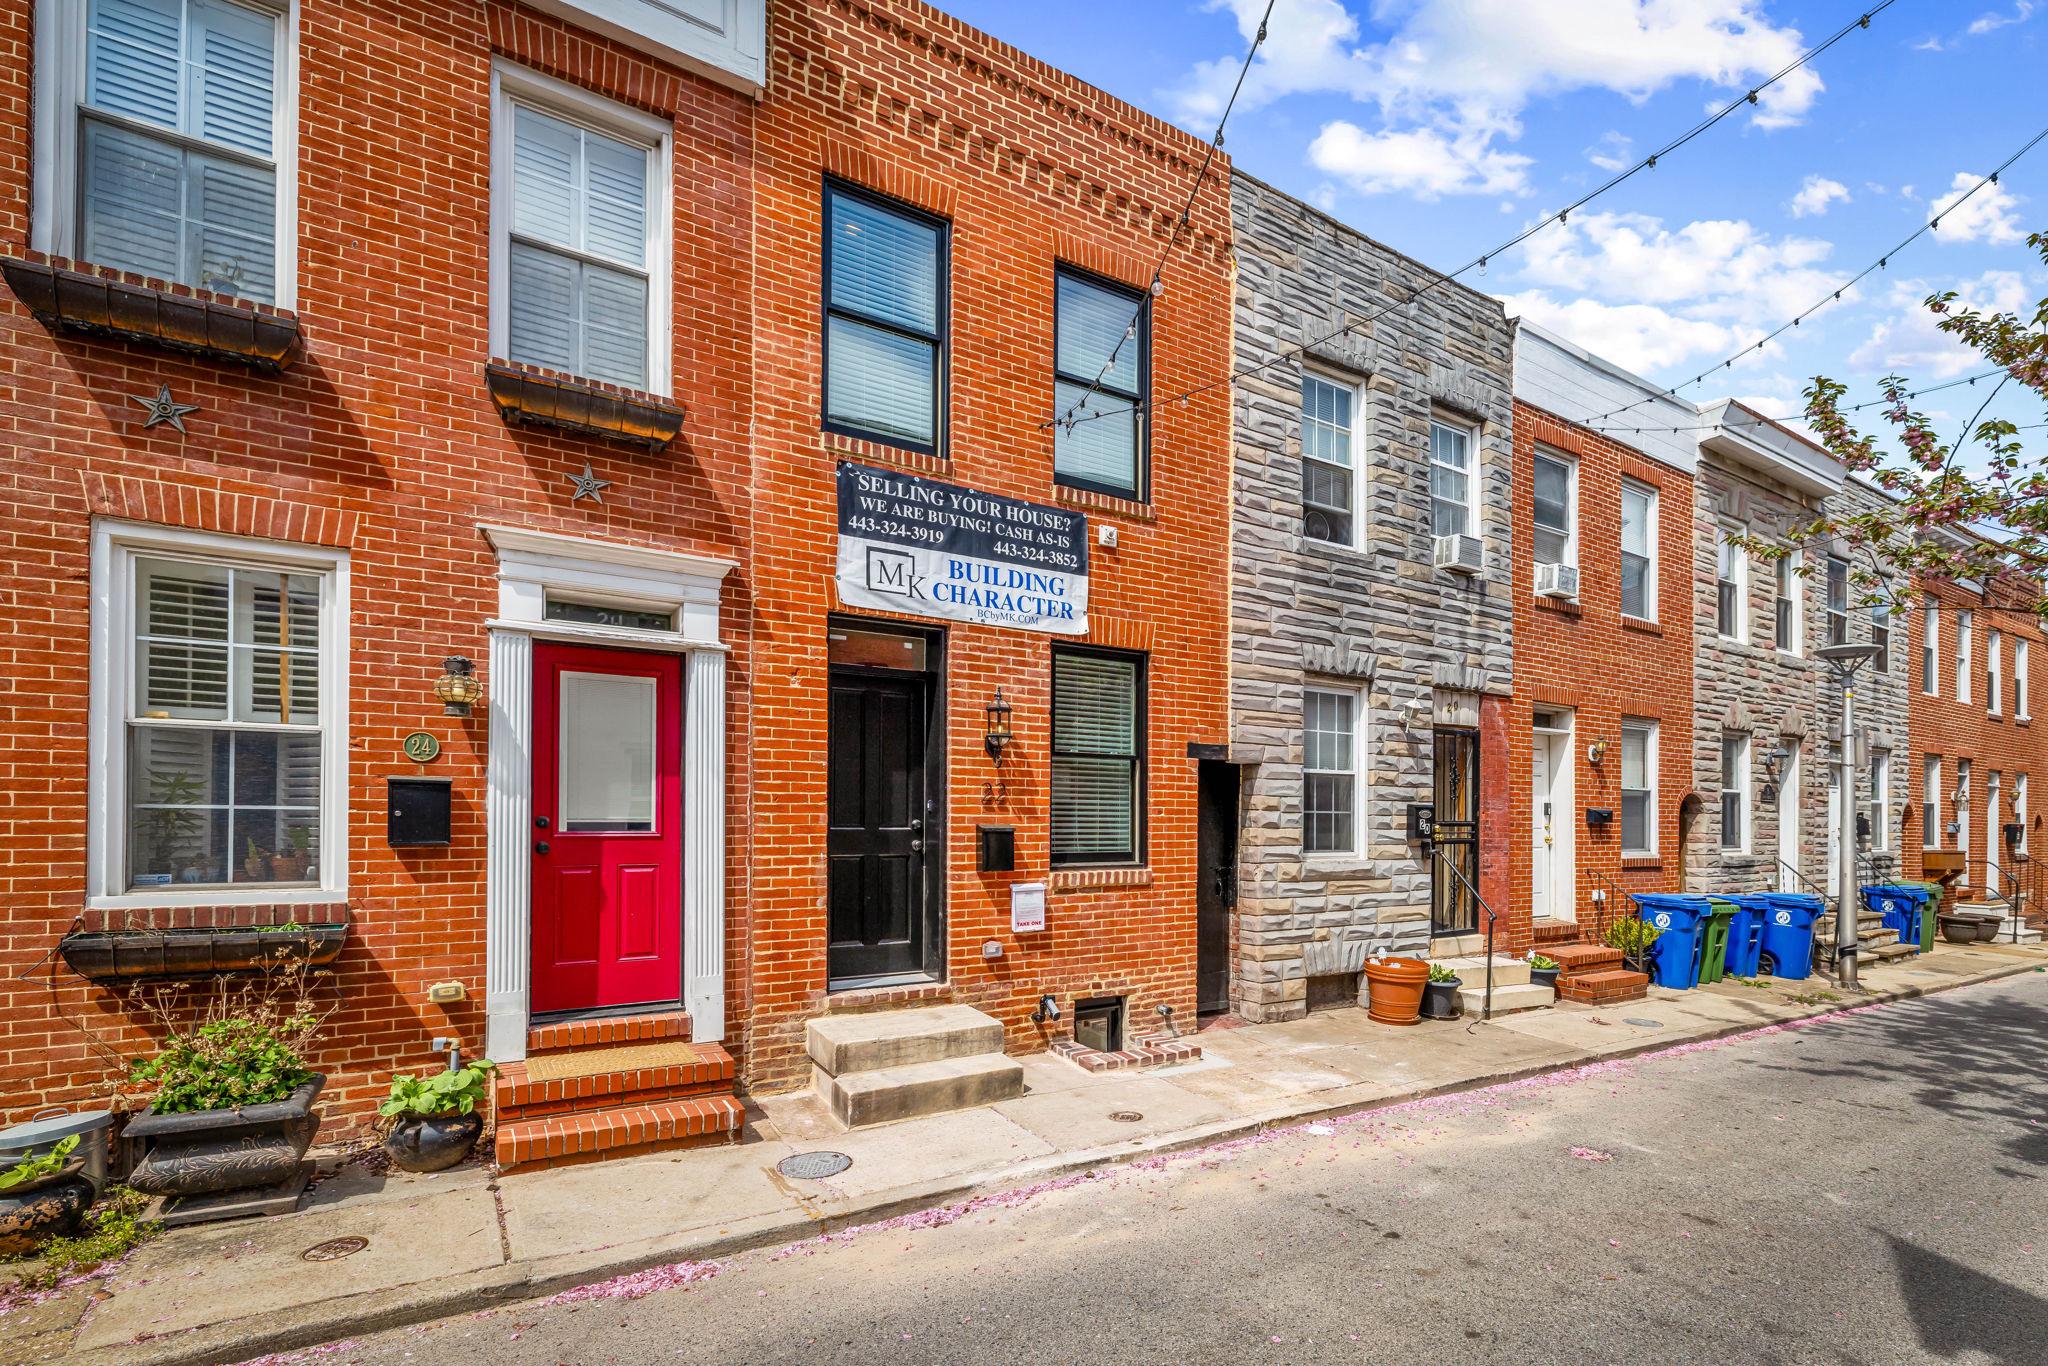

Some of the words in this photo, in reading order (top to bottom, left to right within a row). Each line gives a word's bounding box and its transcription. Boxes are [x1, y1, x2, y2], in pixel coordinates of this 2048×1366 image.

[857, 474, 944, 506] SELLING
[949, 493, 1003, 520] YOUR
[1005, 505, 1072, 532] HOUSE?
[848, 515, 944, 544] 443-324-3919
[859, 496, 888, 514] WE
[891, 503, 925, 523] ARE
[927, 510, 991, 534] BUYING!
[995, 523, 1034, 542] CASH
[1036, 531, 1071, 549] AS-IS
[993, 540, 1078, 568] 443-324-3852
[948, 559, 1065, 597] BUILDING
[932, 582, 1075, 621] CHARACTER
[976, 608, 1039, 626] BCbyMK.COM
[1447, 701, 1459, 713] 20
[411, 737, 431, 755] 24
[981, 782, 1006, 802] 22
[1419, 818, 1431, 835] 20
